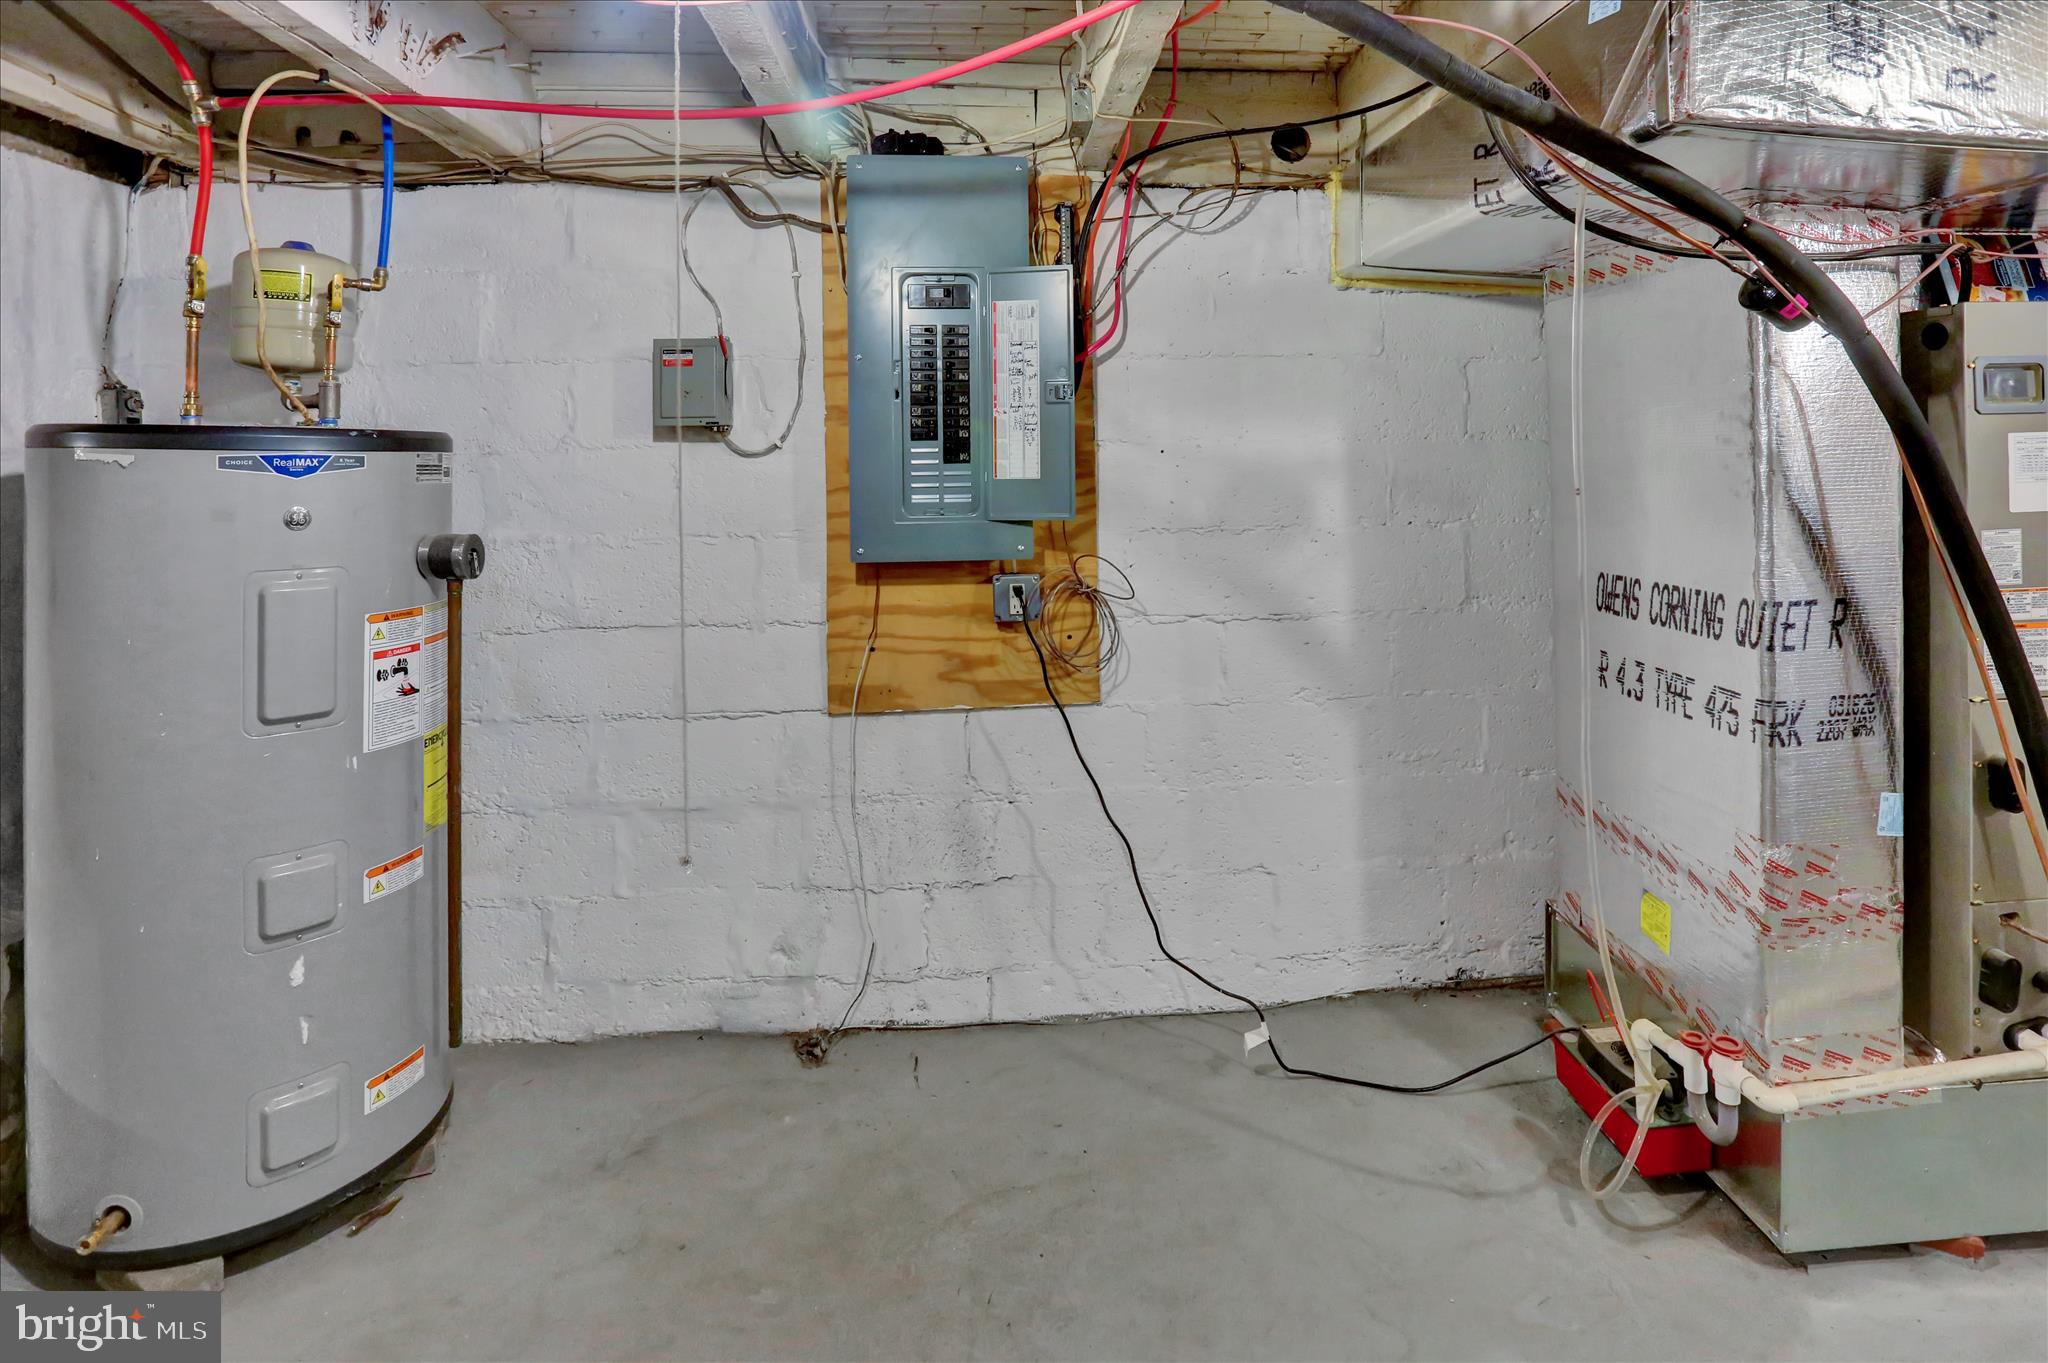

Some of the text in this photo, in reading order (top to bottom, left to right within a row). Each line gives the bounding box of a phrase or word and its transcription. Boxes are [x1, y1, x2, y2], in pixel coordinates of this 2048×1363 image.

[1596, 571, 1848, 652] OWENS CORNING QUIET R
